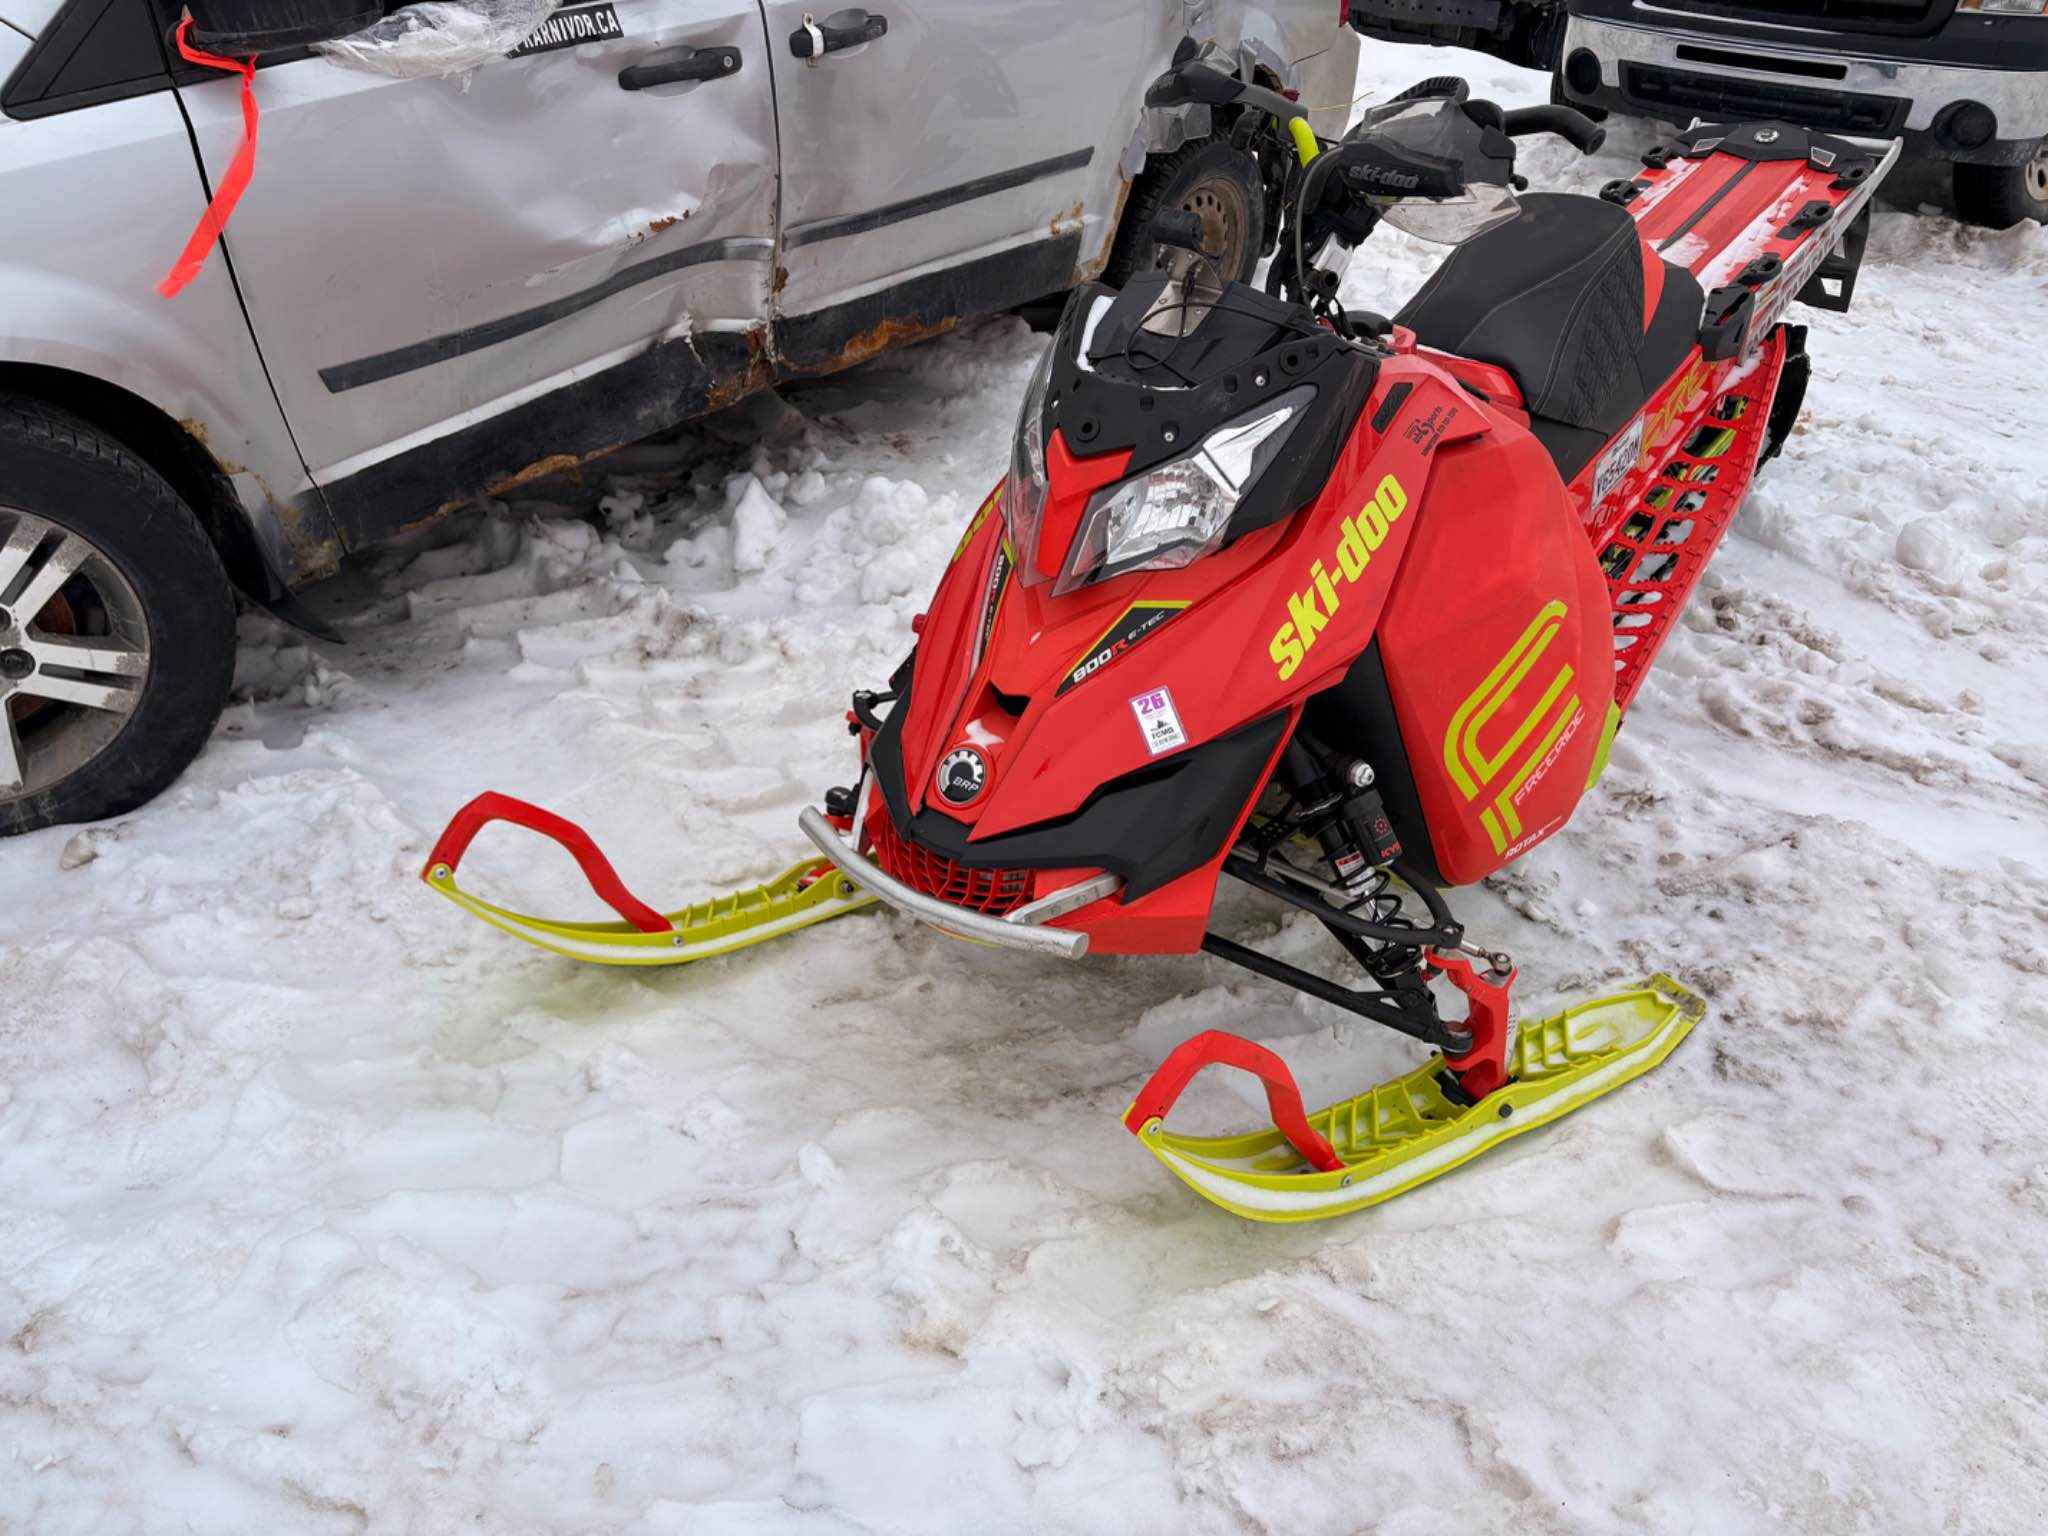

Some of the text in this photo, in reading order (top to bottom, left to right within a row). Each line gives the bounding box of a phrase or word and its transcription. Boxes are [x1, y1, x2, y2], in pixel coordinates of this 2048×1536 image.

[1268, 473, 1408, 682] ski-doo
[1073, 638, 1128, 684] 800R
[1136, 692, 1166, 715] 26
[952, 776, 979, 791] BRP
